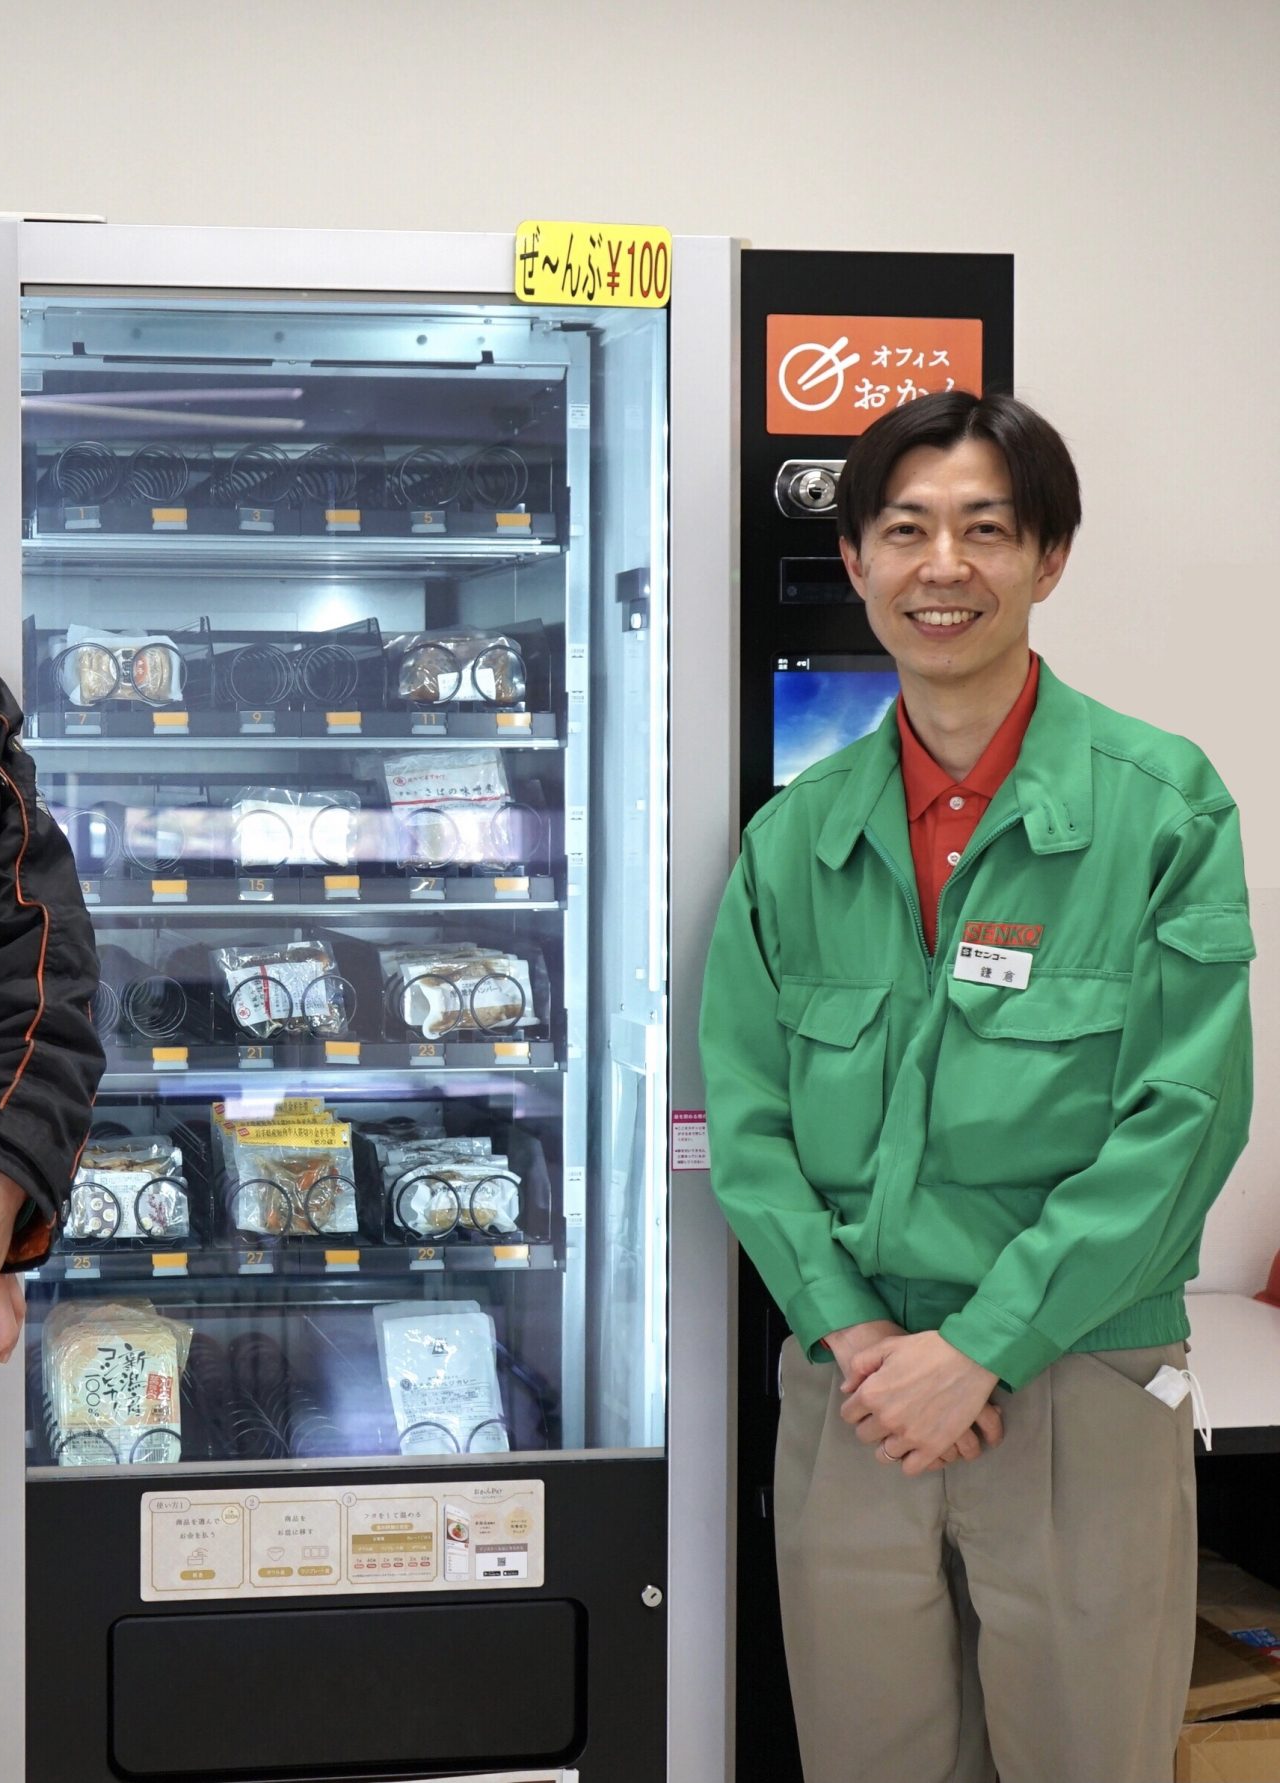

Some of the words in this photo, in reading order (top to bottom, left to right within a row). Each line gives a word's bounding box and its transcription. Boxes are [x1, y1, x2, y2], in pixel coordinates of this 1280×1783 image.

[871, 345, 950, 369] オフィス
[79, 507, 85, 520] 1
[252, 509, 260, 521] 3
[424, 512, 433, 524] 5
[78, 712, 87, 725] 7
[252, 712, 261, 725] 9
[422, 713, 436, 725] 11
[248, 880, 265, 891] 15
[965, 924, 1040, 946] SENKO
[974, 949, 1007, 961] センコー
[247, 1047, 263, 1059] 21
[418, 1045, 435, 1057] 23
[247, 1251, 263, 1264] 27
[418, 1248, 435, 1260] 29
[73, 1257, 91, 1269] 25
